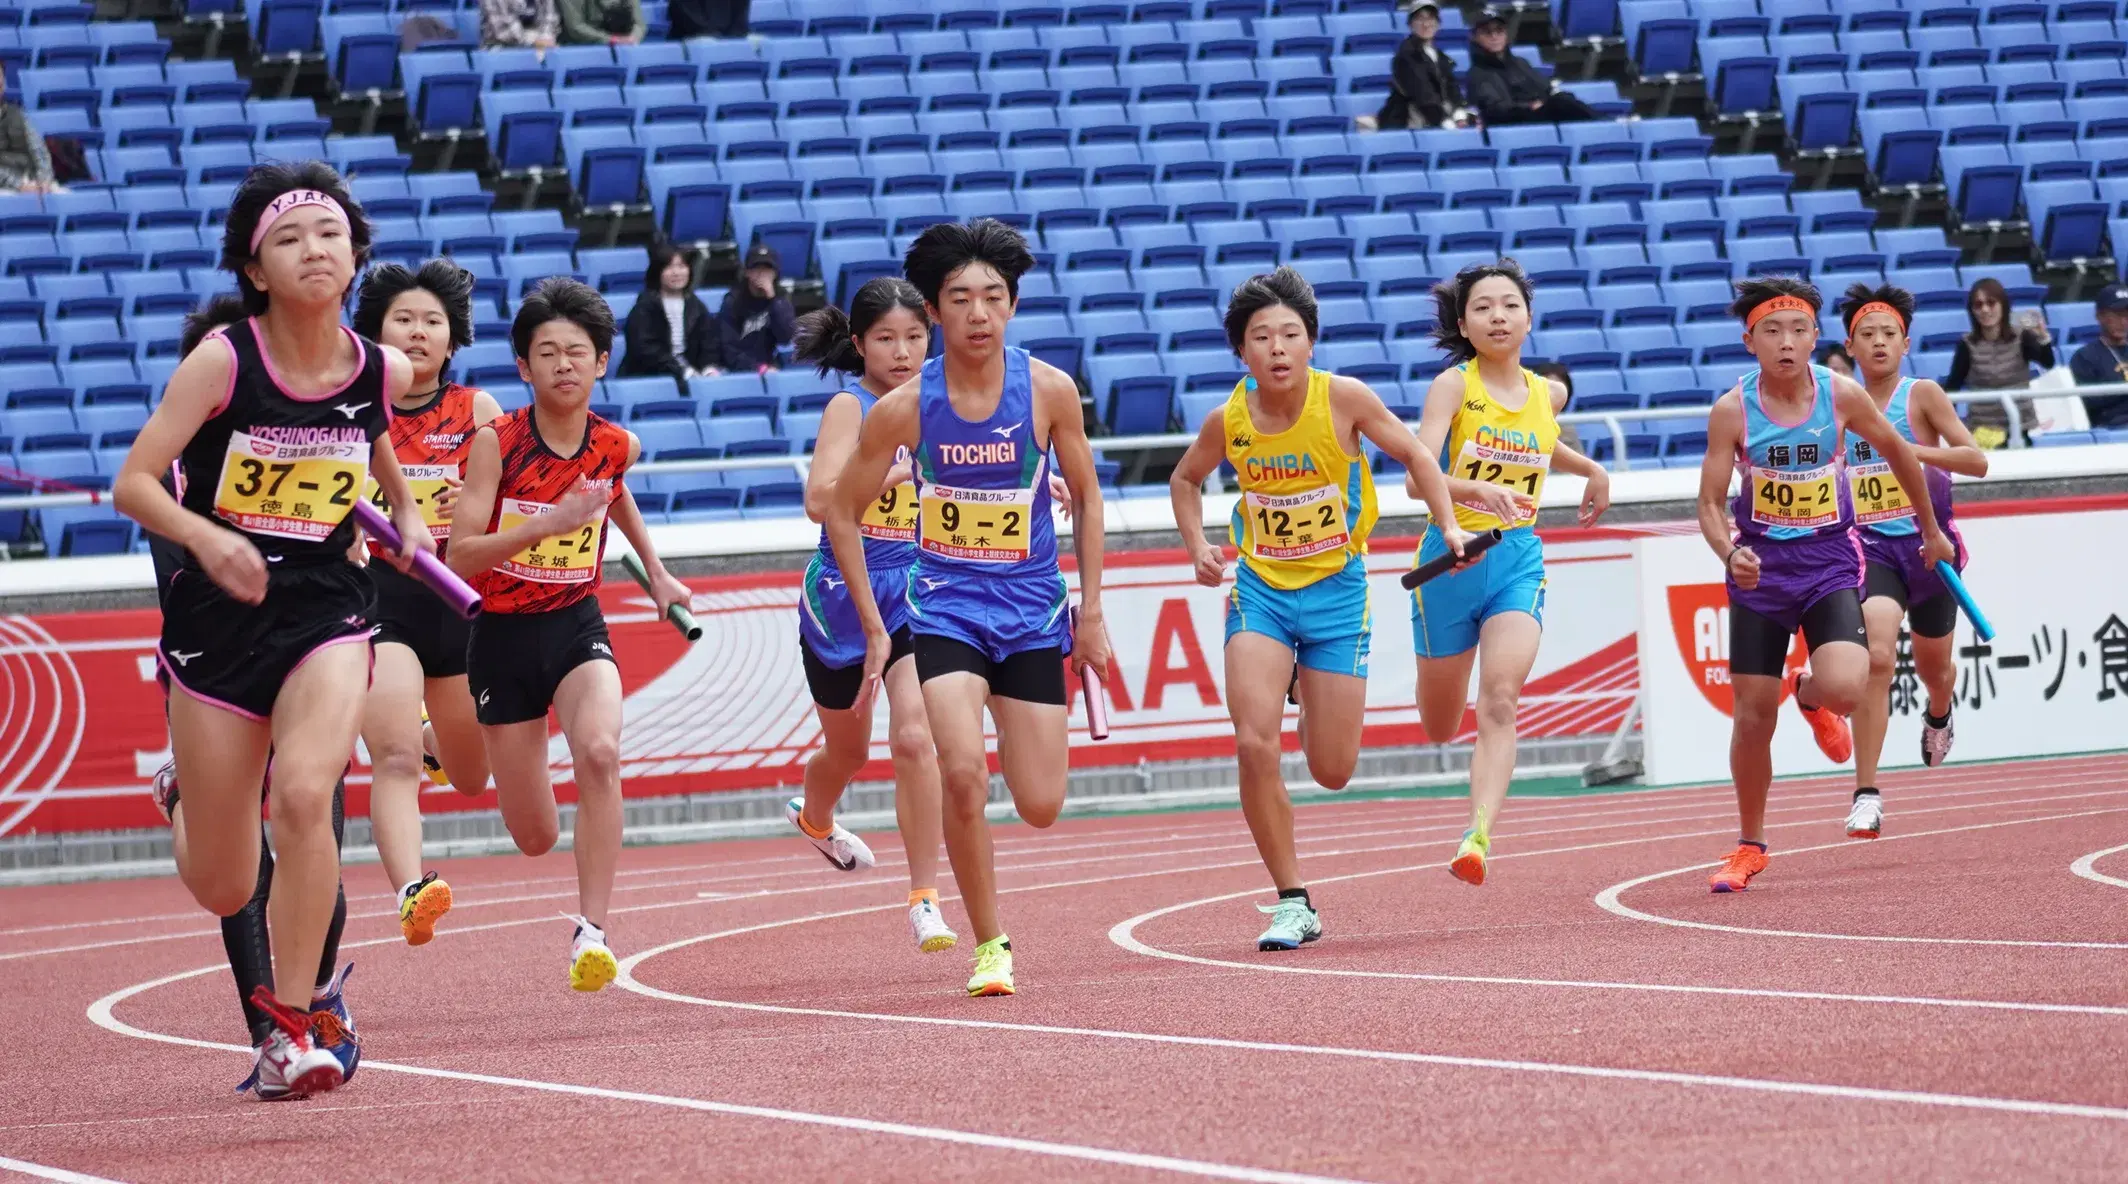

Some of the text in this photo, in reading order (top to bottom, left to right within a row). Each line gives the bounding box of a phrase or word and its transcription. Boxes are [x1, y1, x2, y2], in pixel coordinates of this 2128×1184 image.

[250, 425, 366, 445] YOSHINOGAWA
[422, 433, 465, 444] STARTLINE
[1475, 425, 1540, 454] CHIBA
[277, 445, 356, 459] 日清食品グループ
[939, 442, 1016, 465] TOCHIGI
[1493, 452, 1541, 464] 日清食品グループ
[1767, 443, 1819, 467] 福岡
[1855, 441, 1883, 461] 福
[401, 468, 445, 477] 食品グループ
[1246, 452, 1318, 482] CHIBA
[954, 490, 1018, 503] 日清食品グループ
[1857, 476, 1899, 503] 40-
[259, 498, 313, 519] 徳島
[877, 486, 920, 514] 9-
[884, 515, 918, 528] 栃木
[950, 533, 991, 547] 栃木
[1276, 533, 1314, 548] 千葉
[528, 553, 569, 568] 宮城
